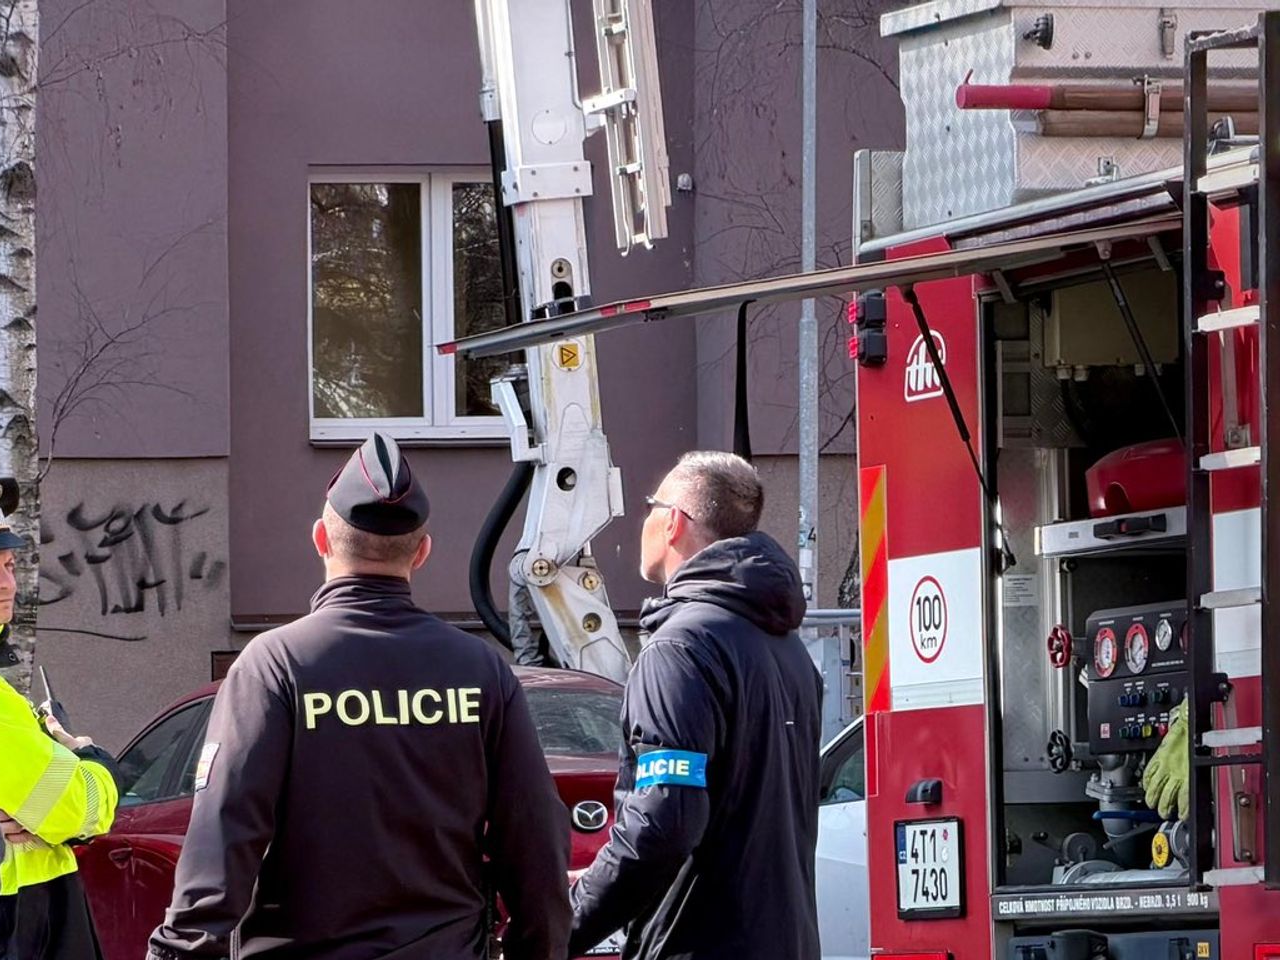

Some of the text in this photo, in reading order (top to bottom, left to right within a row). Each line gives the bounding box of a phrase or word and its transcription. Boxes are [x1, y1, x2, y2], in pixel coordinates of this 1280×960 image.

[916, 594, 942, 632] 100
[920, 633, 937, 649] km
[303, 687, 482, 729] POLICIE
[911, 829, 936, 864] 4T1
[911, 867, 948, 903] 7430
[1199, 892, 1208, 908] kg
